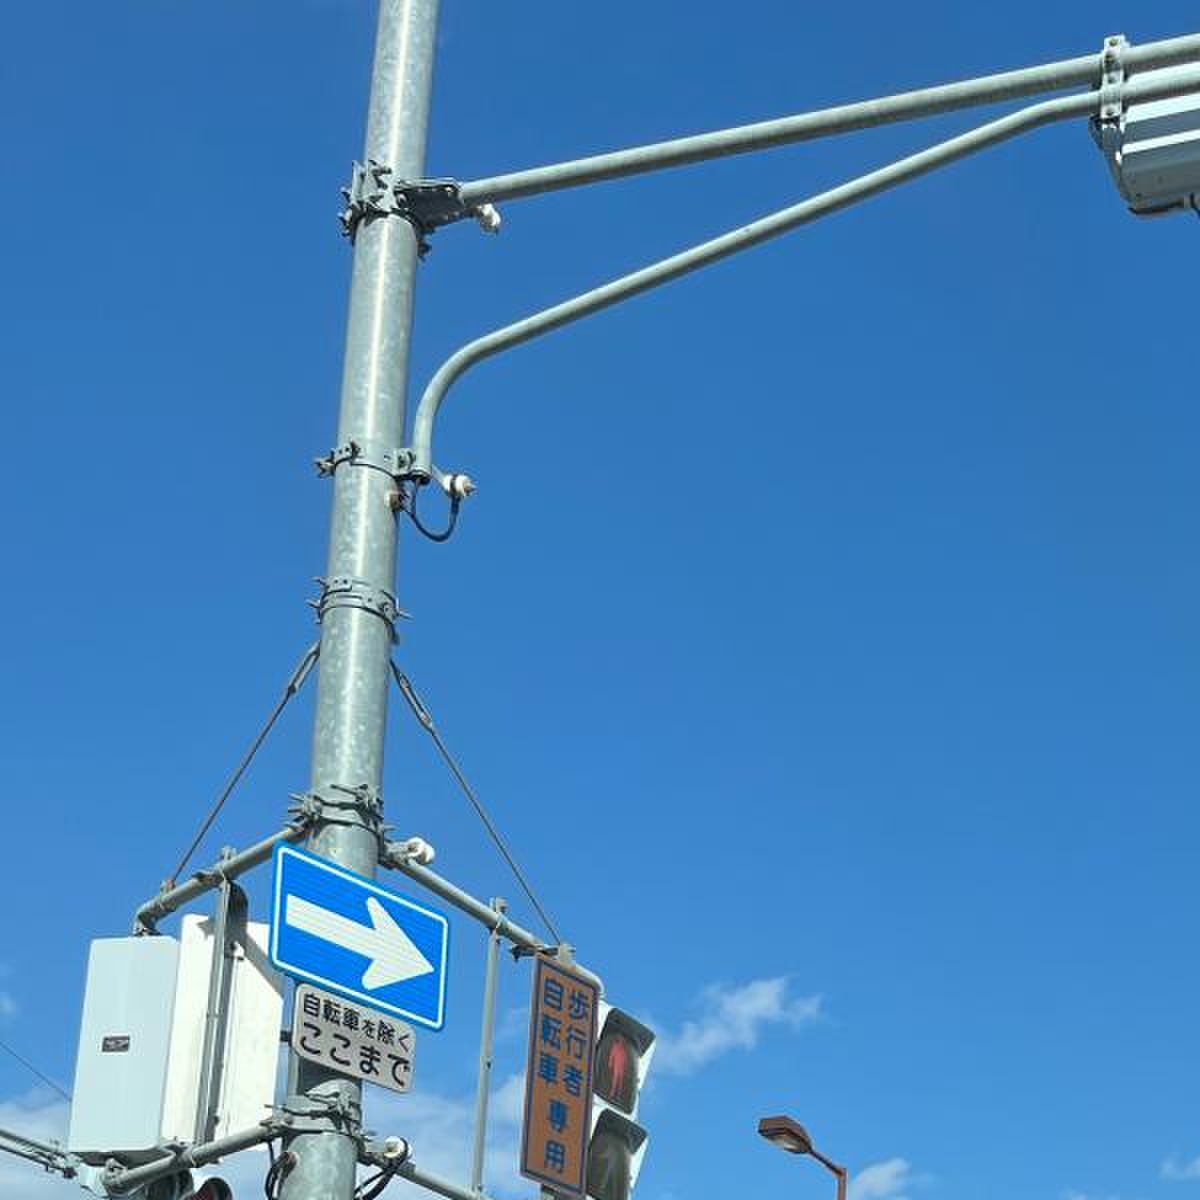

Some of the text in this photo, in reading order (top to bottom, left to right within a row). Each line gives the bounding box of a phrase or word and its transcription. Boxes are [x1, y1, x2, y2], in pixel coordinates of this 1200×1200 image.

[300, 1021, 411, 1088] ここまで
[303, 993, 410, 1053] 自転車を除く
[539, 975, 565, 1085] 自転車
[563, 988, 589, 1098] 歩行者
[545, 1099, 567, 1174] 専用
